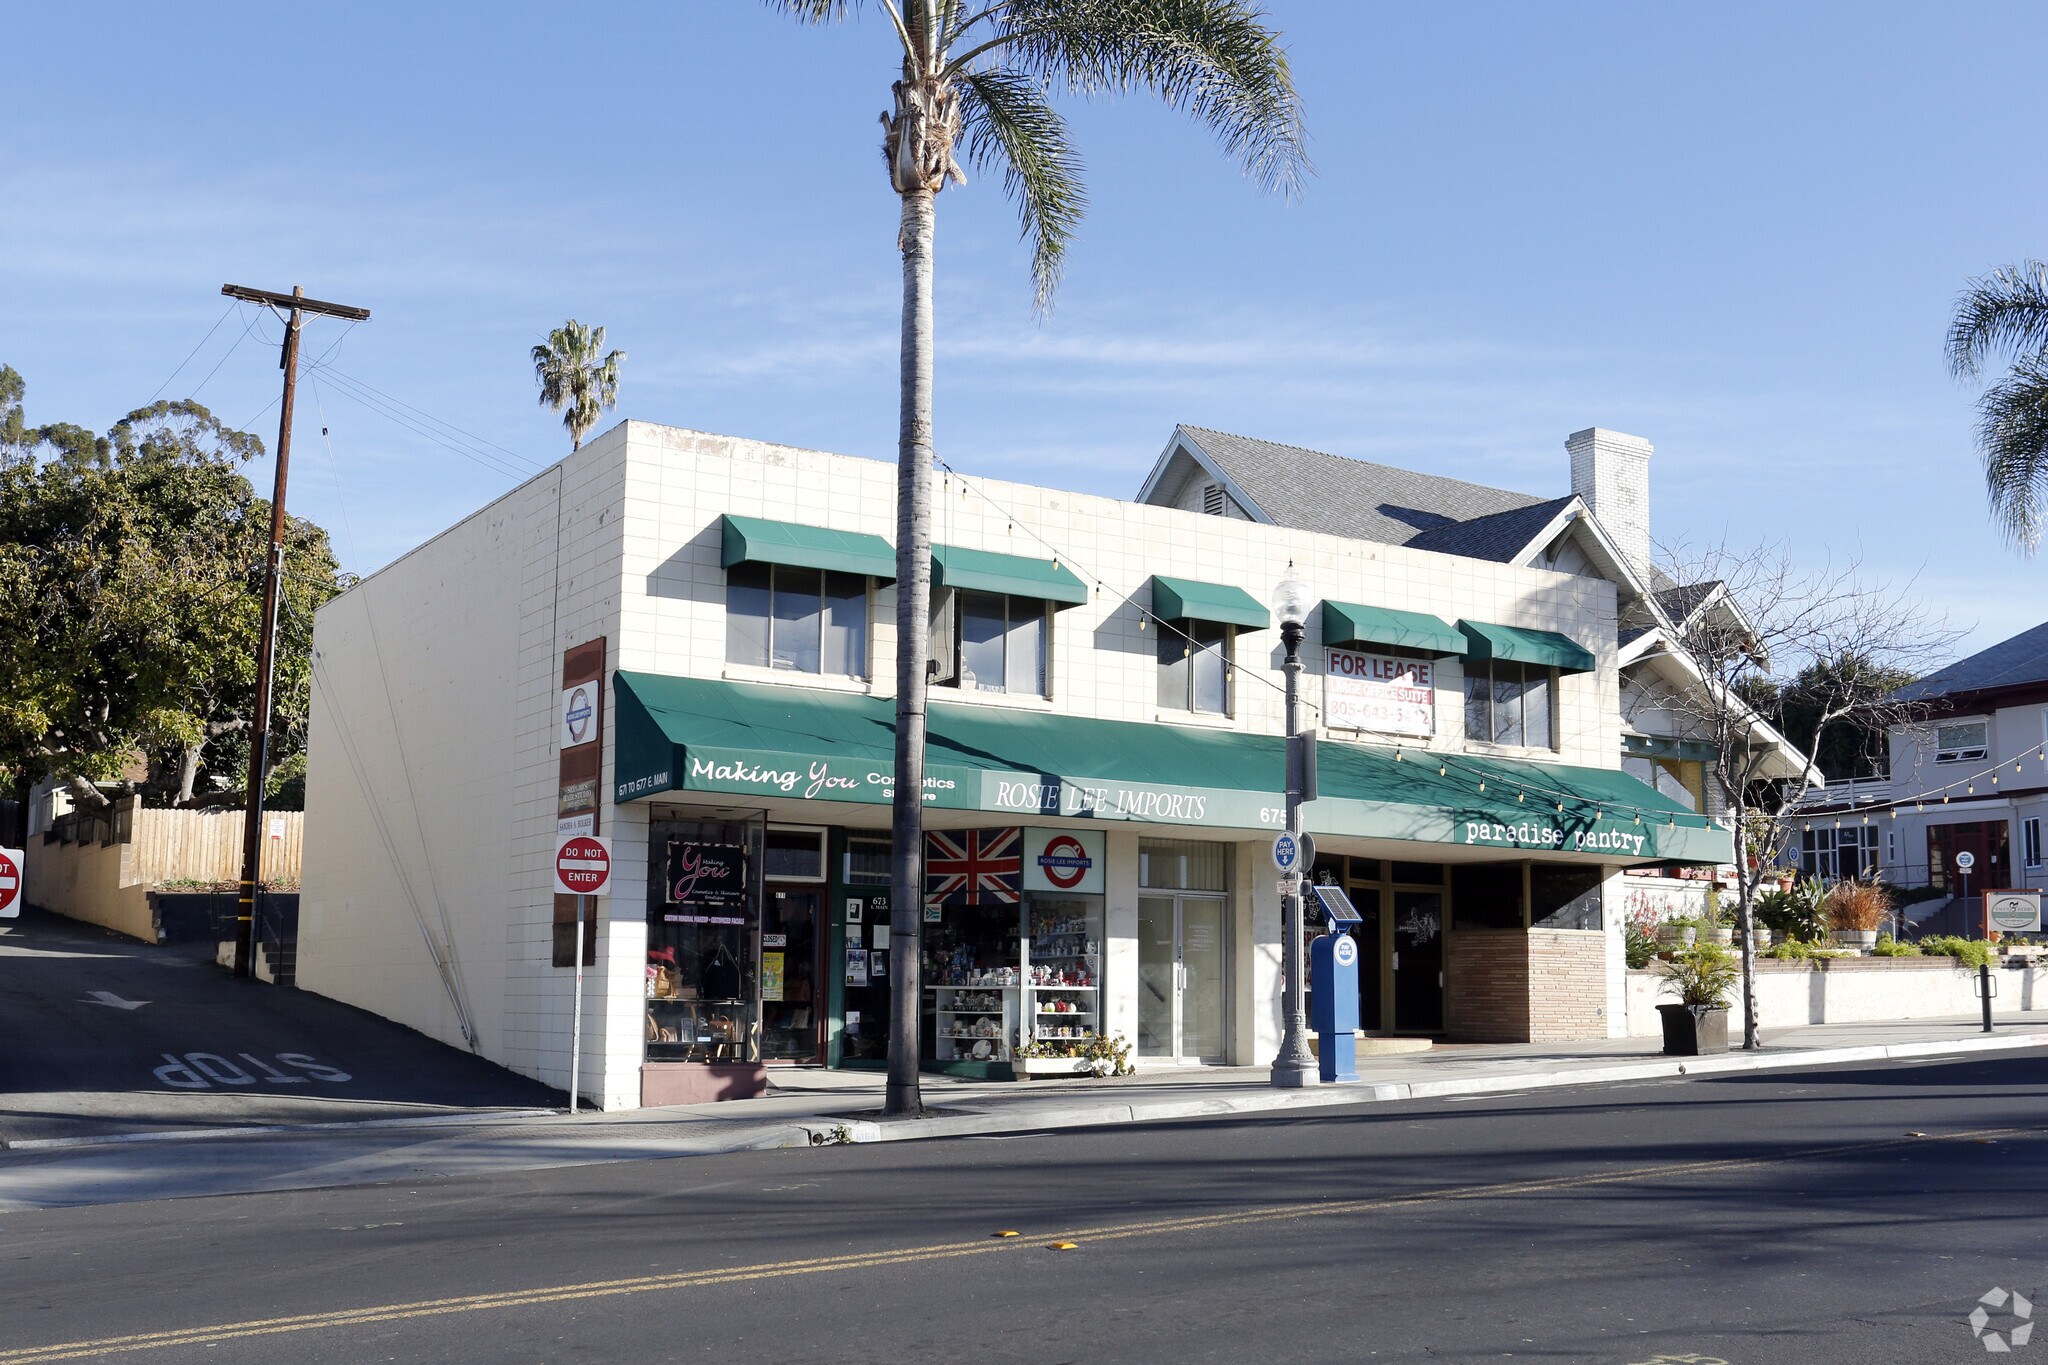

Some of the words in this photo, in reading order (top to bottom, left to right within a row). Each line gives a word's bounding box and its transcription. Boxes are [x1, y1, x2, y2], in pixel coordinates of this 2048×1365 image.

[1330, 652, 1367, 677] FOR
[1373, 659, 1429, 684] LEASE
[1331, 679, 1361, 697] LARGE
[1363, 684, 1397, 700] OFFICE
[1398, 688, 1428, 702] SUITE
[618, 783, 628, 797] 671
[628, 781, 636, 794] TO
[636, 777, 647, 791] 677
[653, 771, 668, 786] MAIN
[690, 757, 803, 791] Making
[804, 761, 860, 800] You
[995, 781, 1060, 810] ROSIE
[1066, 786, 1108, 813] LEE
[1114, 790, 1207, 820] IMPORTS
[1465, 820, 1564, 846] paradise
[1573, 827, 1646, 856] pantry
[565, 847, 579, 857] DO
[584, 848, 602, 858] NOT
[702, 859, 724, 867] Making
[1276, 848, 1294, 856] HERE
[568, 872, 598, 882] ENTER
[674, 846, 730, 900] You
[872, 896, 887, 905] 673
[763, 935, 778, 943] CLOSED
[153, 1052, 353, 1089] STOP
